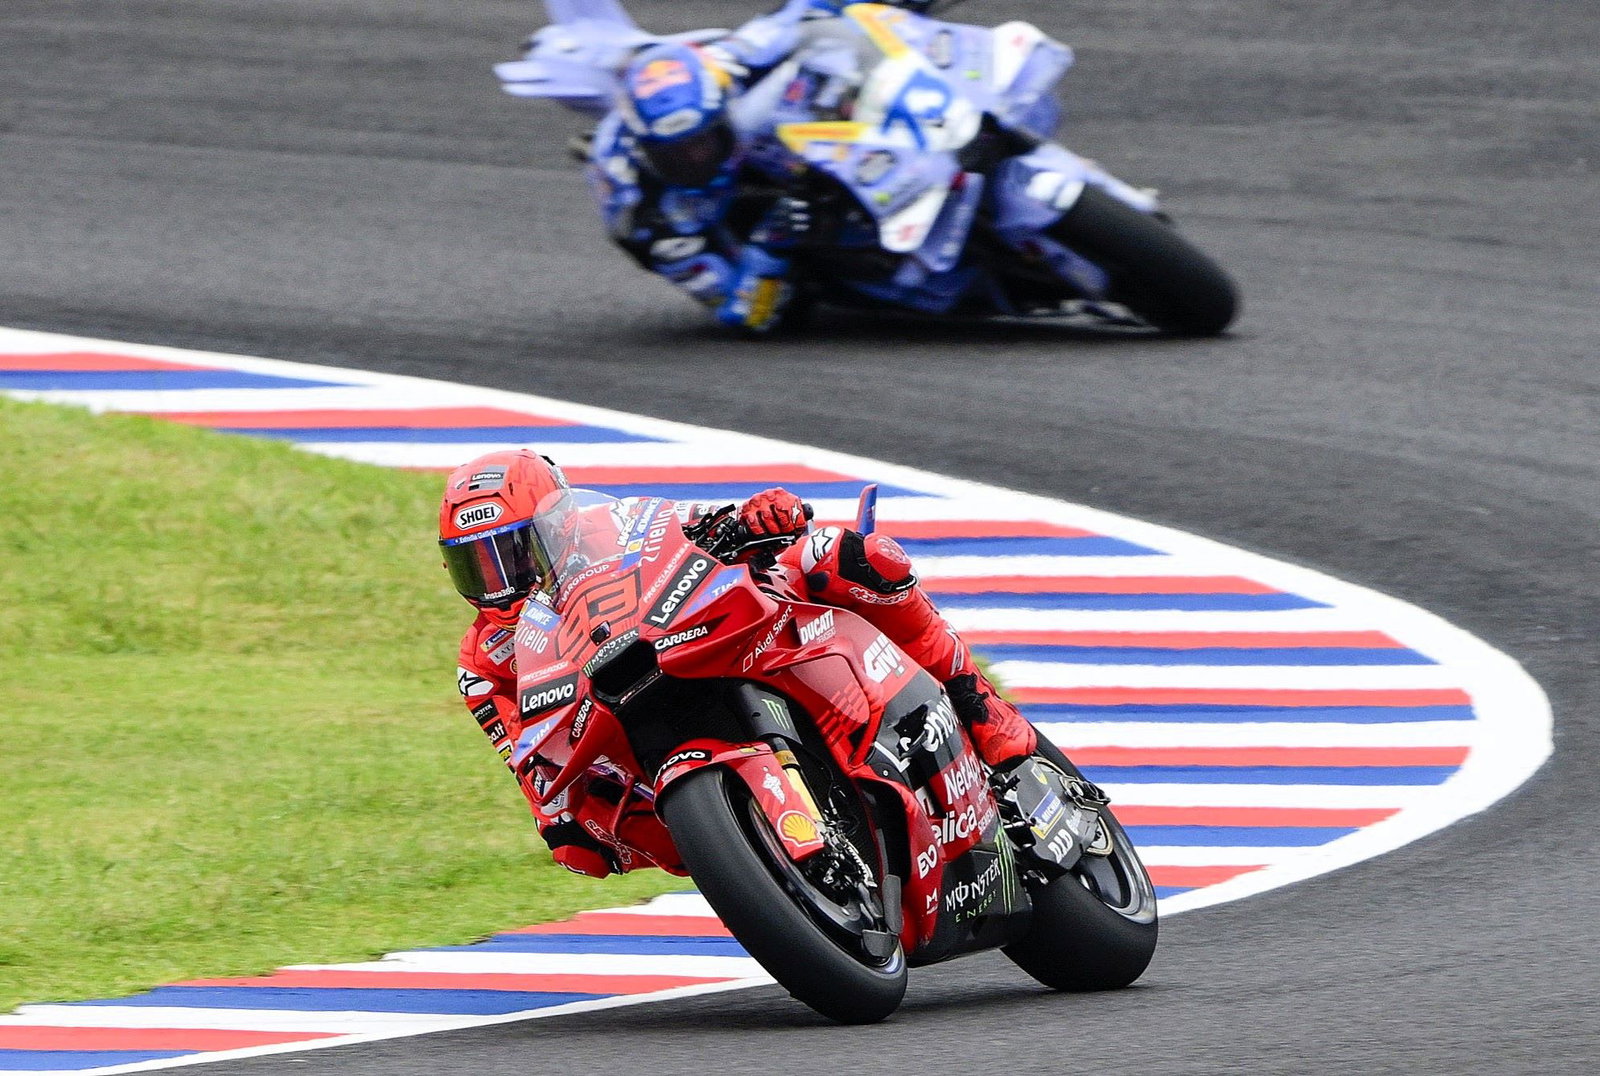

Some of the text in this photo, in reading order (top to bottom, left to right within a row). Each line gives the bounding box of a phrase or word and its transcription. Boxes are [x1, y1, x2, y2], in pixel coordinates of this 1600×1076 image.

[459, 506, 496, 526] SHOEI
[650, 558, 708, 624] Lenovo
[654, 625, 709, 651] CARRERA
[754, 604, 793, 659] Audi Sport
[800, 608, 835, 646] DUCATI
[521, 682, 575, 714] Lenovo
[571, 698, 593, 739] CARRERA
[944, 858, 1000, 912] MONSTER
[954, 890, 998, 924] ENERGY
